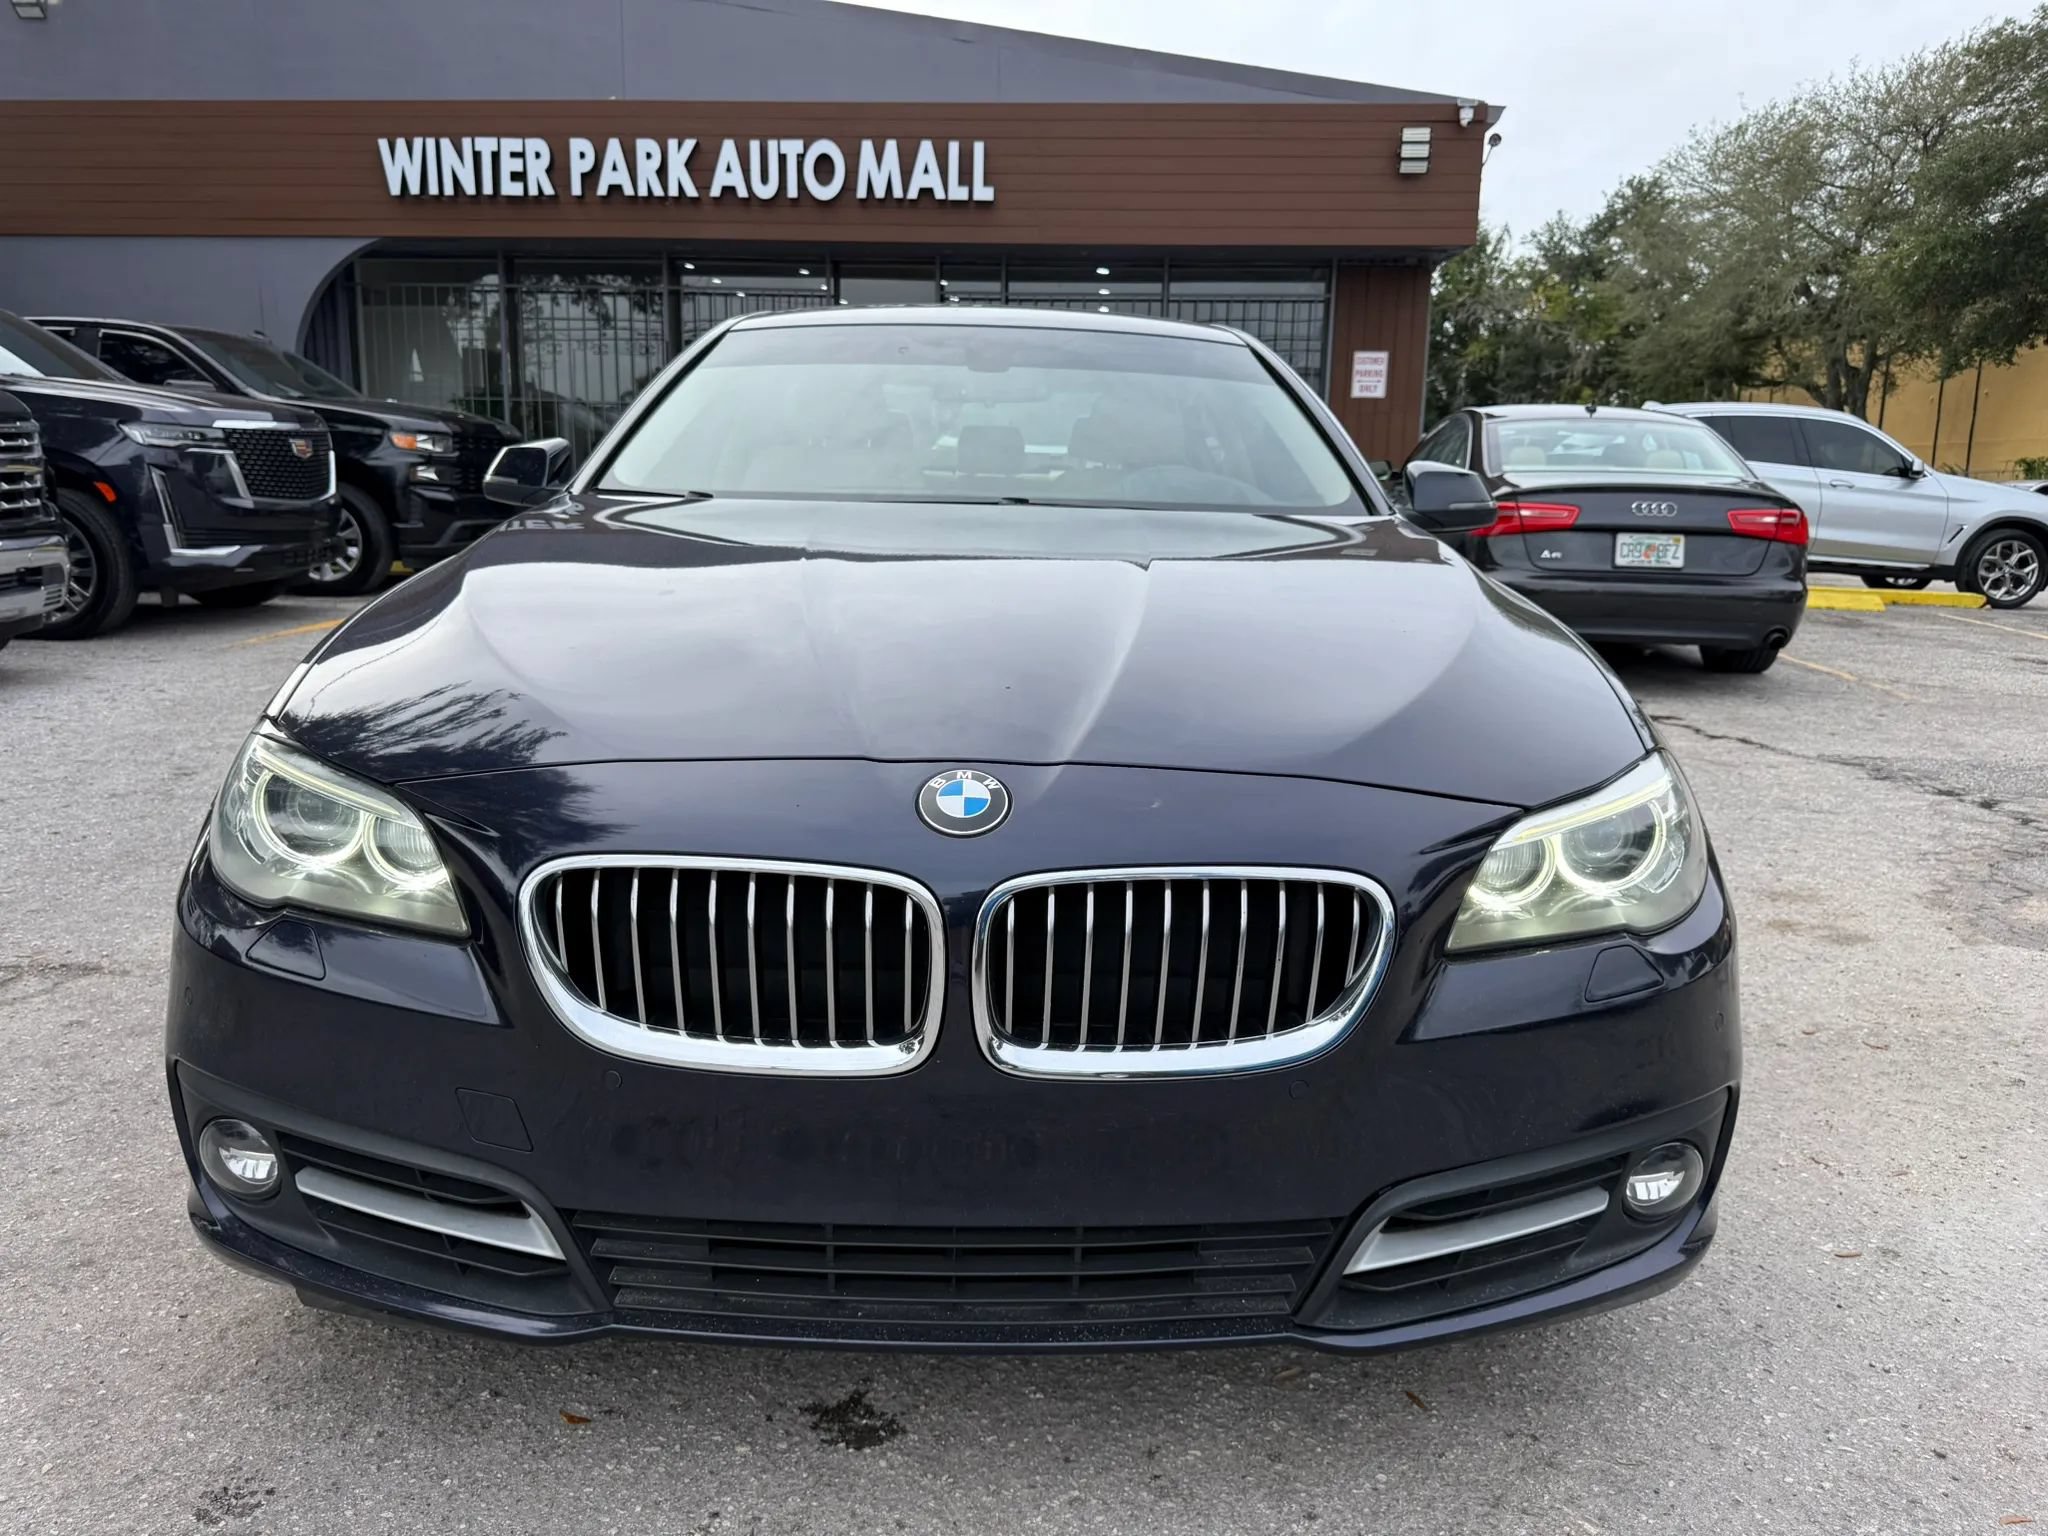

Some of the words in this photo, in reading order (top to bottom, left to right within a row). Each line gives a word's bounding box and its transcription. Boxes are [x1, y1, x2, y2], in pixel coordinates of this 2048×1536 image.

[377, 136, 555, 196] WINTER
[569, 137, 699, 198] PARK
[709, 138, 846, 201] AUTO
[856, 139, 995, 202] MALL
[929, 771, 1001, 790] BMW
